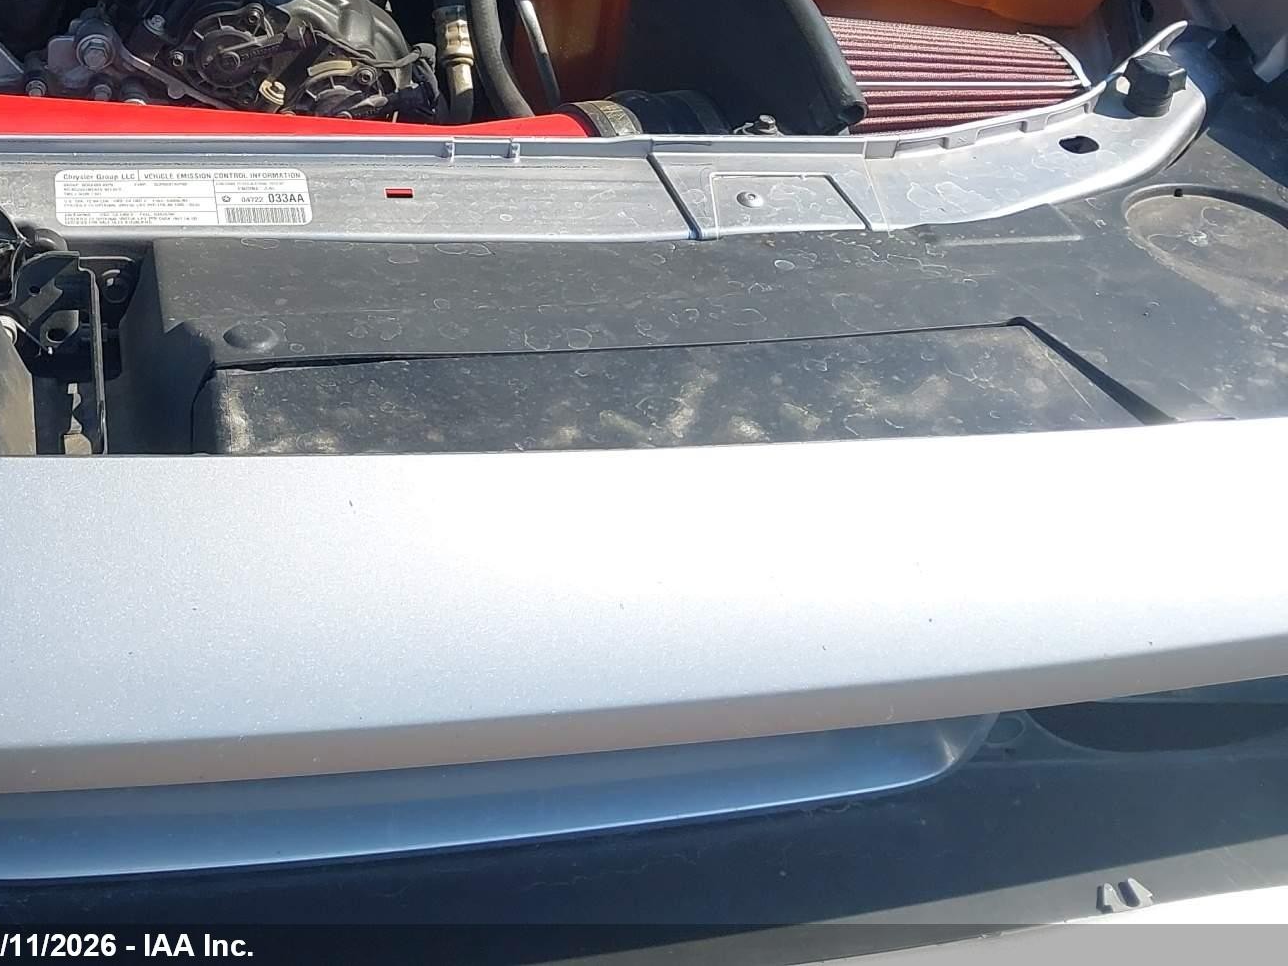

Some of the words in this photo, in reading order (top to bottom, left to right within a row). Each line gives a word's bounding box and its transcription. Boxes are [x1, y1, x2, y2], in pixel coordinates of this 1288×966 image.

[63, 173, 94, 181] Chrysler
[96, 173, 119, 181] Group
[267, 193, 305, 203] 033AA
